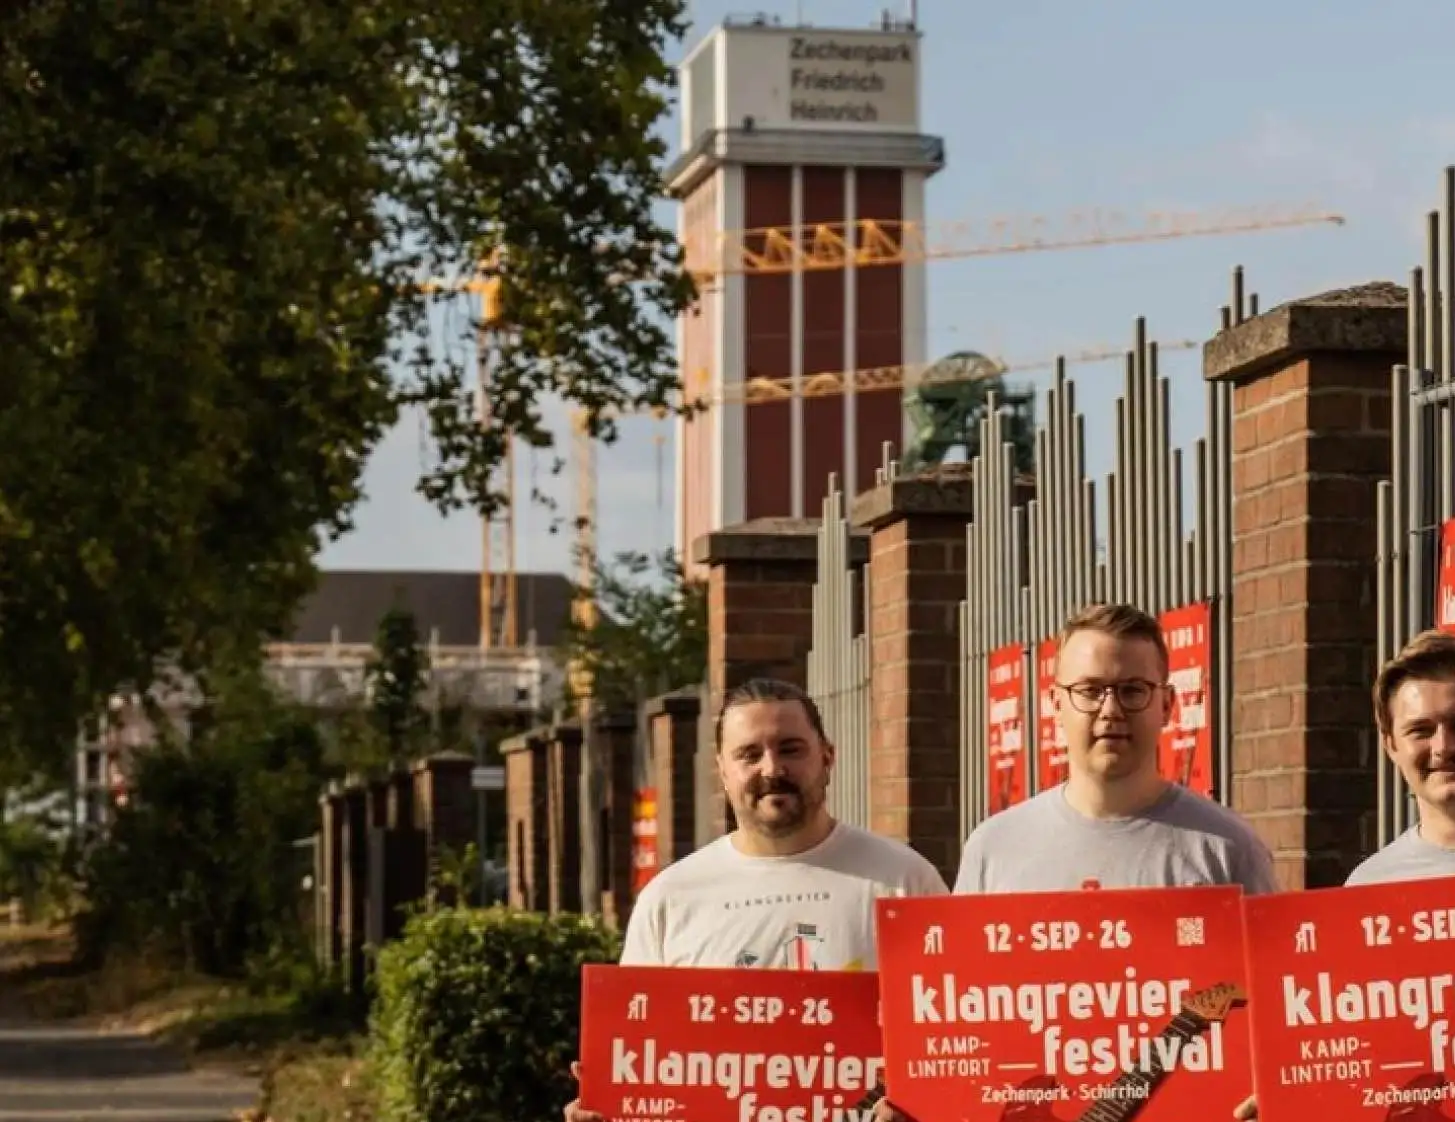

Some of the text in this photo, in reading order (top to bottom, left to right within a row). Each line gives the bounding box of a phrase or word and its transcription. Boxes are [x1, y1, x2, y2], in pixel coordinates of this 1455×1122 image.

[790, 38, 912, 63] Zechenpark
[791, 69, 885, 91] Friedrich
[791, 102, 878, 121] Heinrich
[984, 920, 1132, 952] 12 SEP 26
[1361, 915, 1392, 947] 12
[688, 996, 832, 1026] 12 SEP 26
[912, 966, 1190, 1033] klangrevier
[926, 1036, 990, 1056] KAMP-
[1044, 1021, 1224, 1075] festival
[1301, 1037, 1371, 1060] KAMP-
[612, 1038, 885, 1098] klangrevier
[908, 1058, 990, 1078] LINTFORT
[1281, 1060, 1372, 1085] LINTFORT
[981, 1082, 1150, 1104] Zechenpark Schirrhof
[622, 1097, 686, 1116] KAMP-
